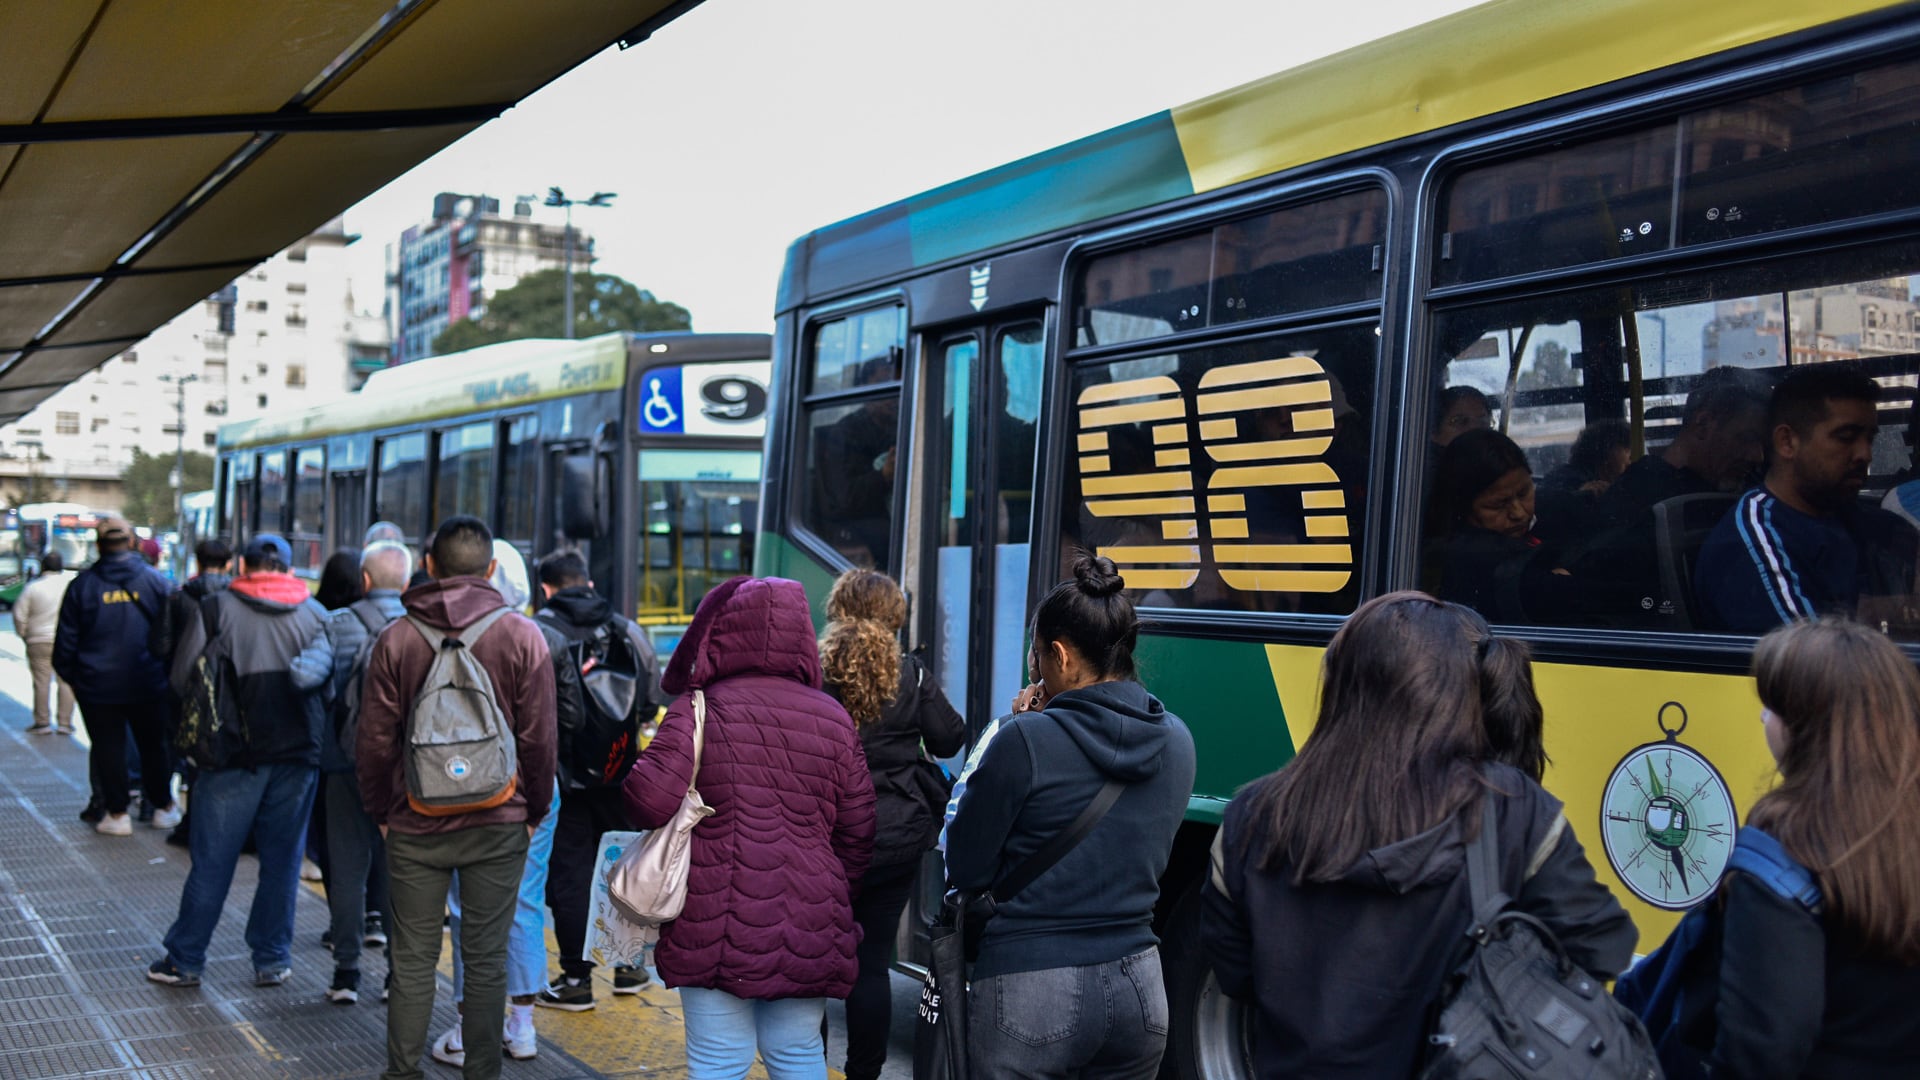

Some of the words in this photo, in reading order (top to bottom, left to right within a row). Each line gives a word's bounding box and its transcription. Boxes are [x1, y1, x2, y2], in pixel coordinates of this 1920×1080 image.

[1077, 356, 1353, 593] 98
[1664, 758, 1673, 778] S
[1629, 773, 1644, 791] SE
[1693, 782, 1711, 800] SW
[1608, 809, 1631, 824] E
[1706, 823, 1724, 843] W
[1658, 870, 1672, 891] N
